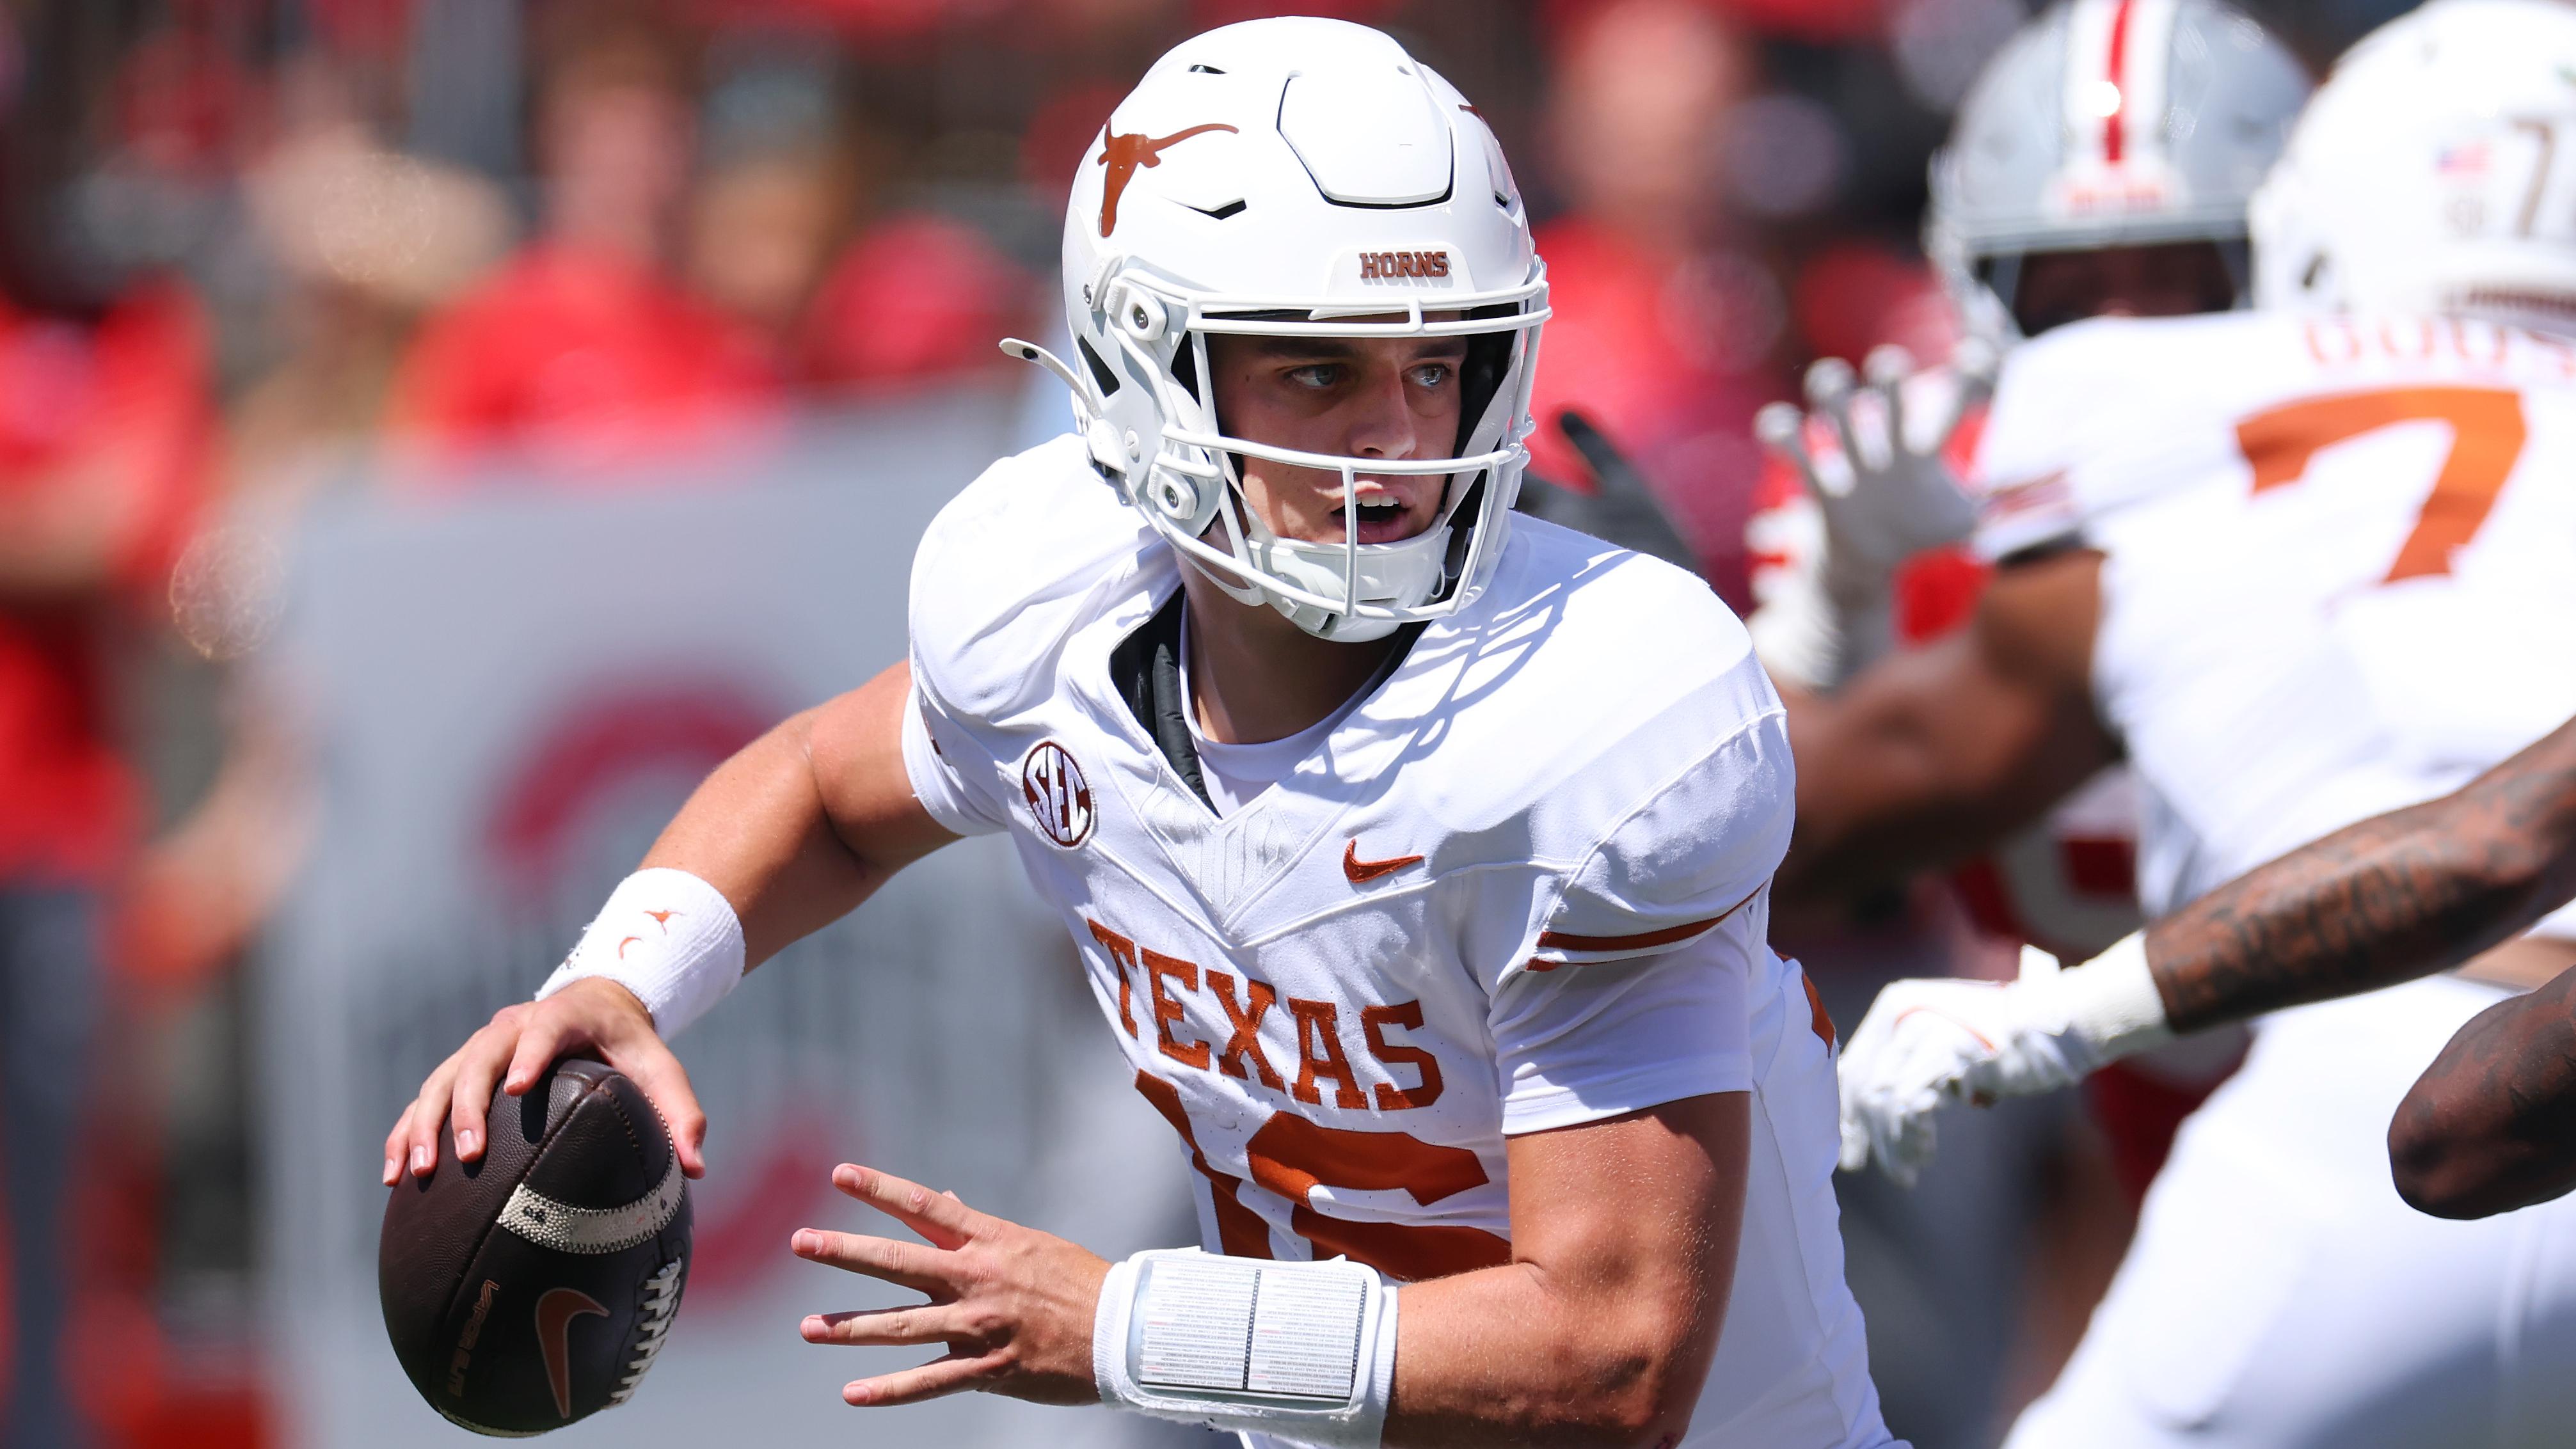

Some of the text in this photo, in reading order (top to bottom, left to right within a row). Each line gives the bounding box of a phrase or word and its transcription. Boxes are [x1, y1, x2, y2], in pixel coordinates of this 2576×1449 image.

[1359, 251, 1449, 279] HORNS
[2234, 385, 2531, 585] 7
[1024, 743, 1092, 842] SEC
[1087, 918, 1443, 1112] TEXAS
